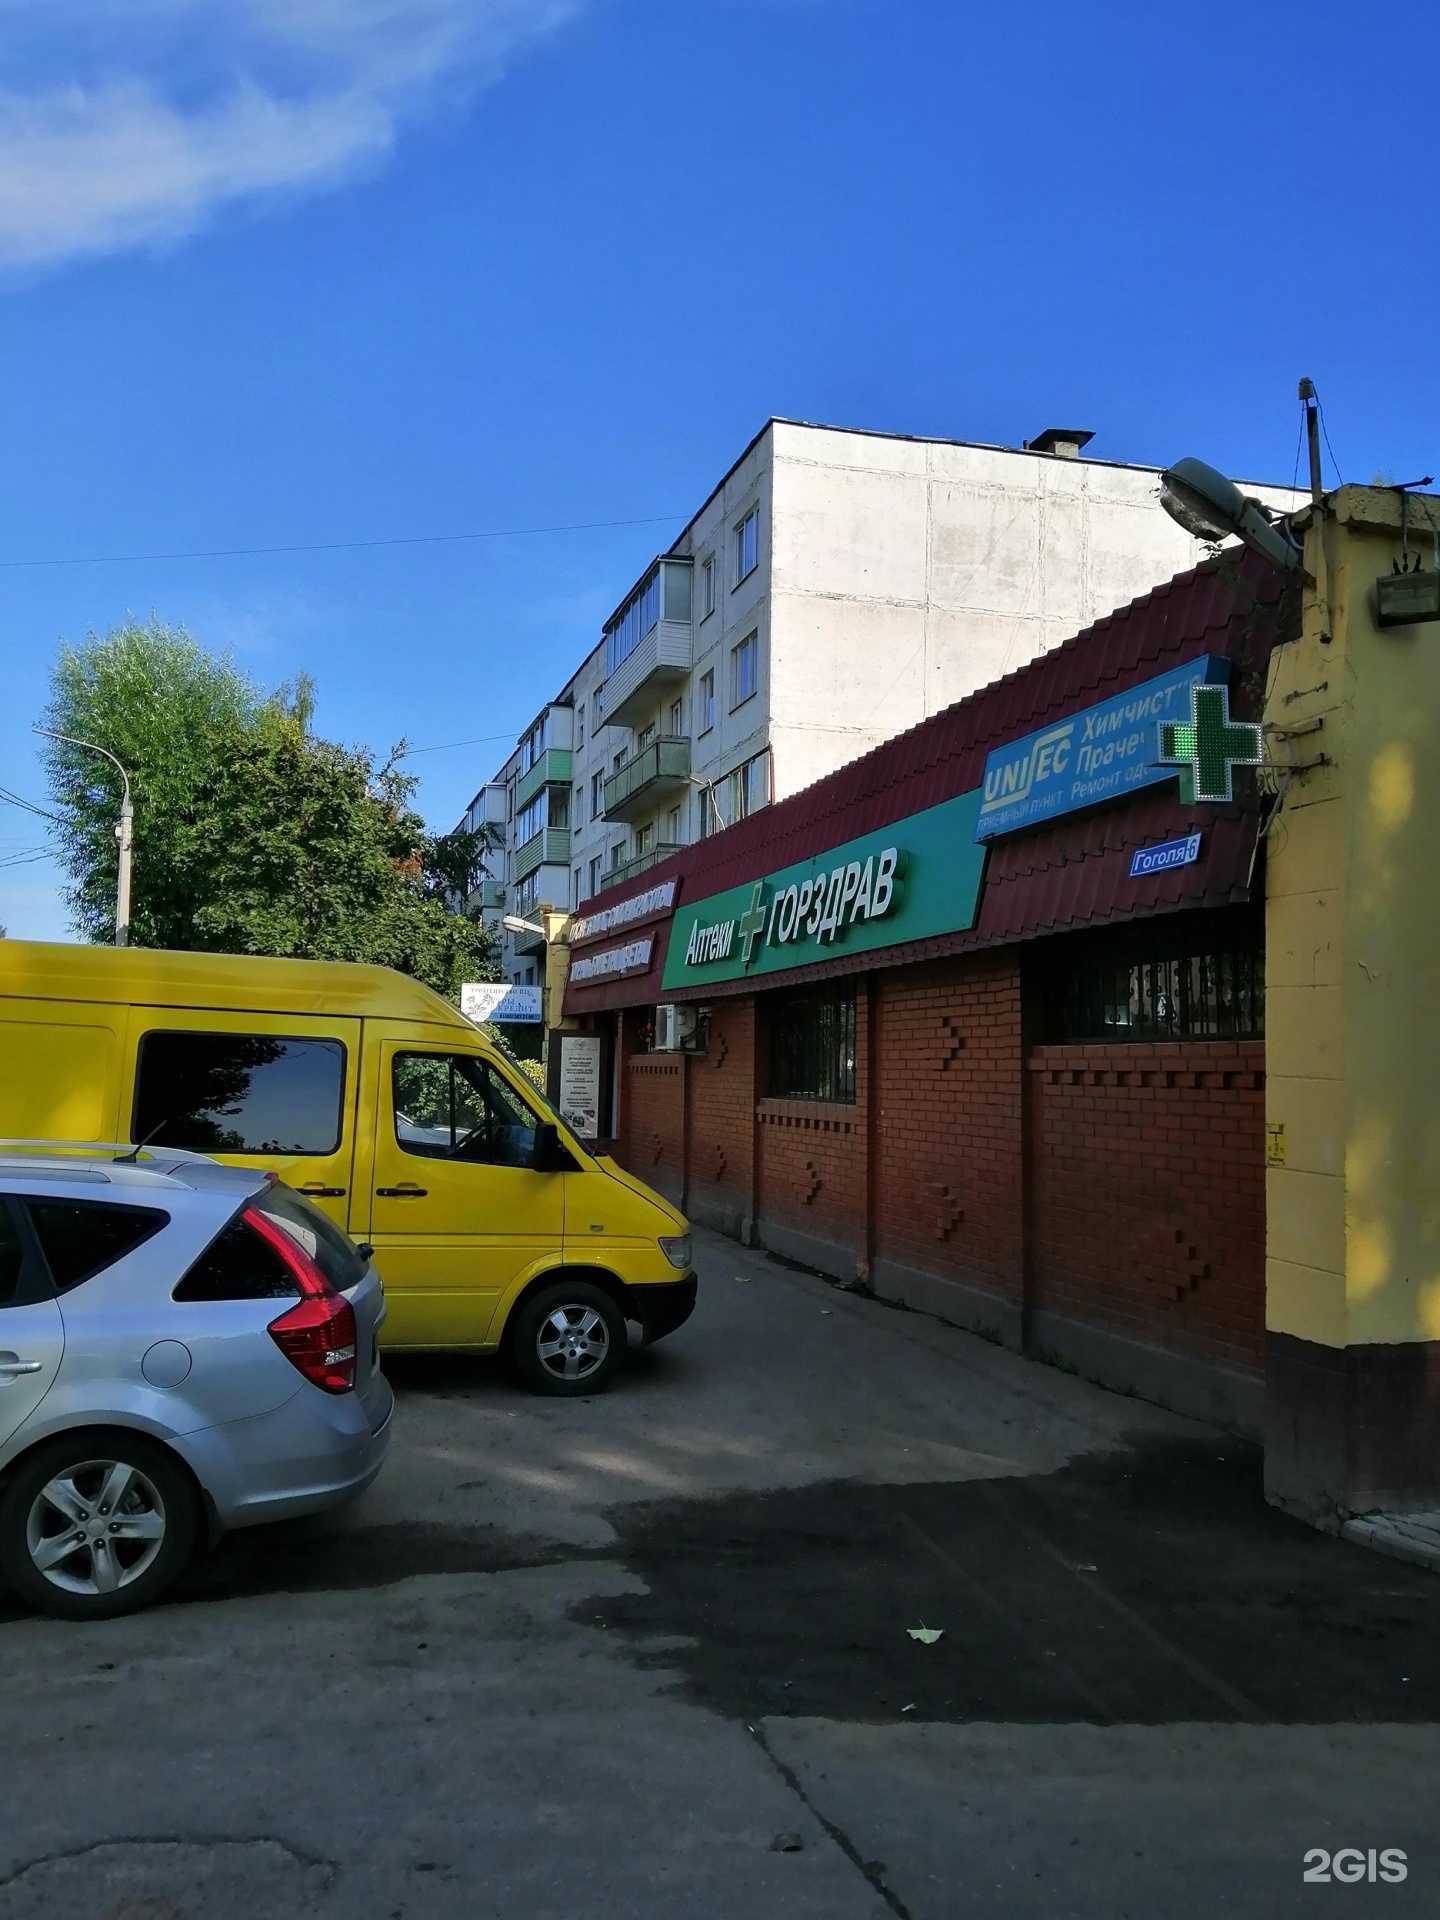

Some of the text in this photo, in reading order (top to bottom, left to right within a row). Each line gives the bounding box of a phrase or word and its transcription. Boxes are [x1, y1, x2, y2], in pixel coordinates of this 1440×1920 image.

[1081, 675, 1201, 743] Химчист
[1076, 732, 1145, 776] Праче
[1030, 790, 1064, 816] ПУНКТ
[1072, 770, 1122, 800] Ремонт
[1134, 838, 1198, 871] Гоголя 6
[686, 919, 735, 966] Аптеки
[766, 847, 898, 945] ГОРЗДРАВ
